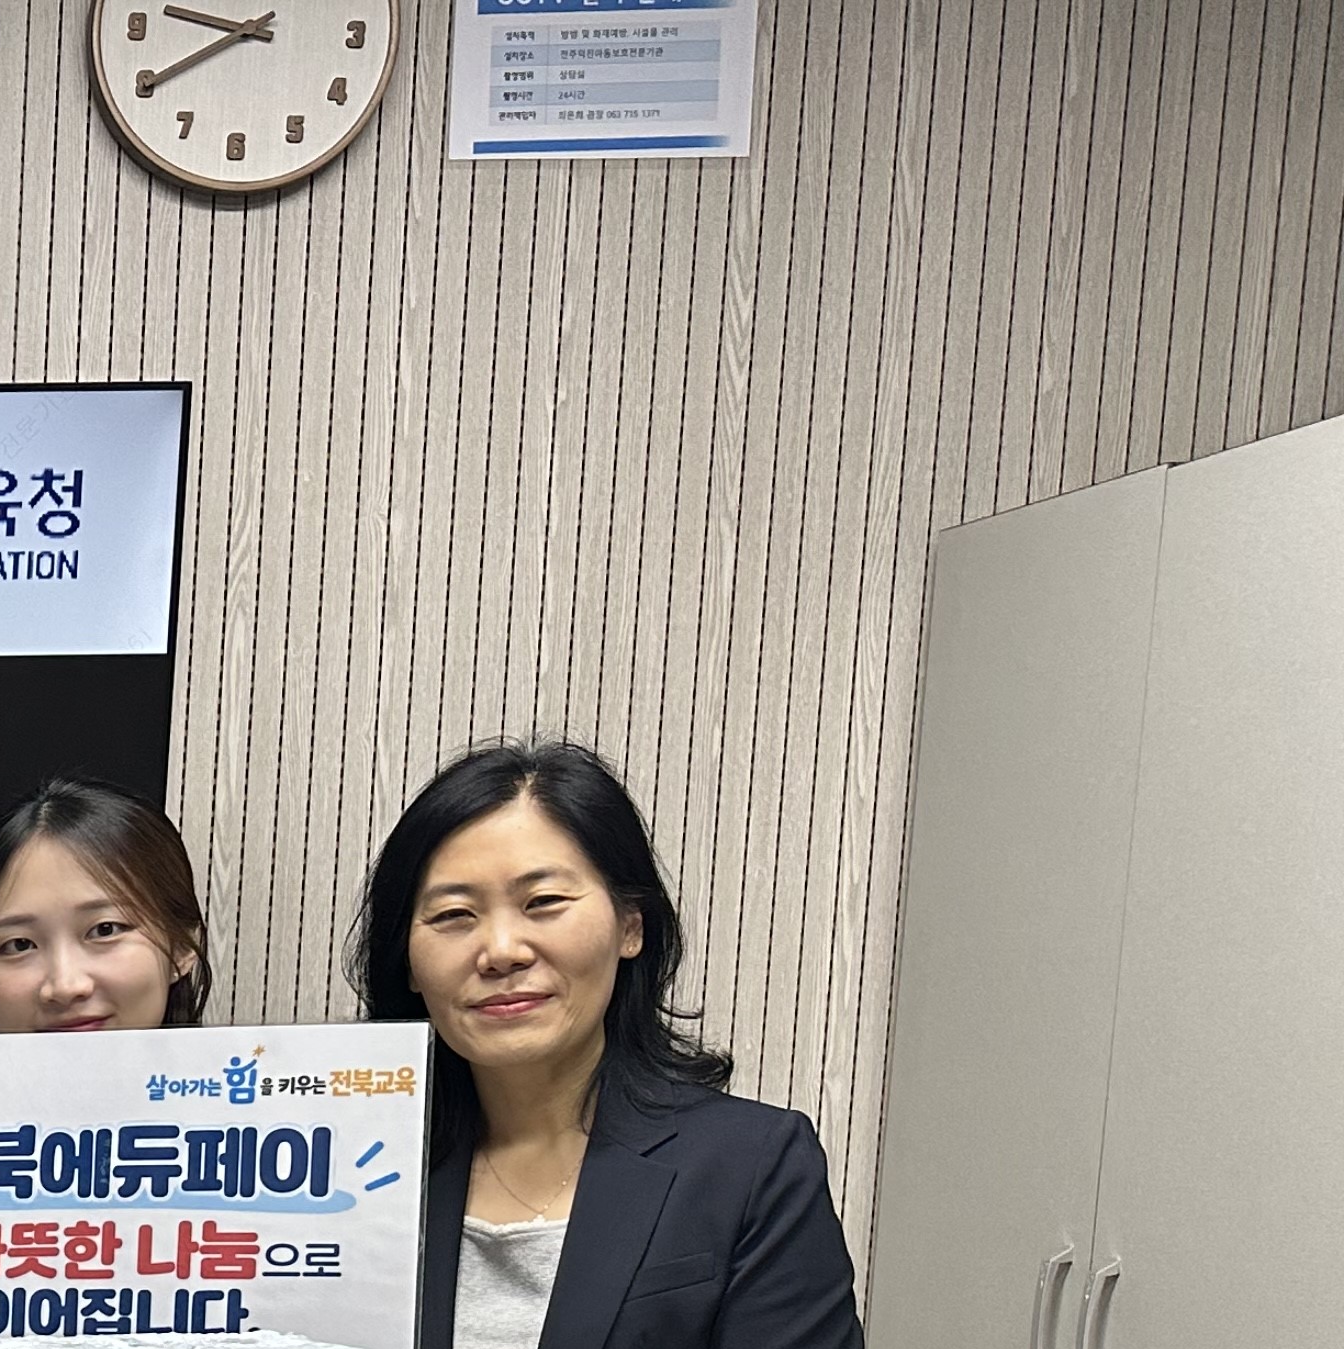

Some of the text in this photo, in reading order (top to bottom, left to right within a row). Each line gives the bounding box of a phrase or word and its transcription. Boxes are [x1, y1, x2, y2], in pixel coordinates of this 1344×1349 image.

[127, 13, 149, 41] 9
[345, 20, 366, 49] 3
[326, 77, 349, 106] 4
[177, 111, 196, 140] 7
[285, 115, 305, 145] 5
[226, 132, 246, 162] 6
[145, 1073, 222, 1101] 살아가는
[278, 1075, 327, 1097] 키우는
[328, 1067, 417, 1097] 전북교육
[136, 1218, 343, 1281] 나눔으로
